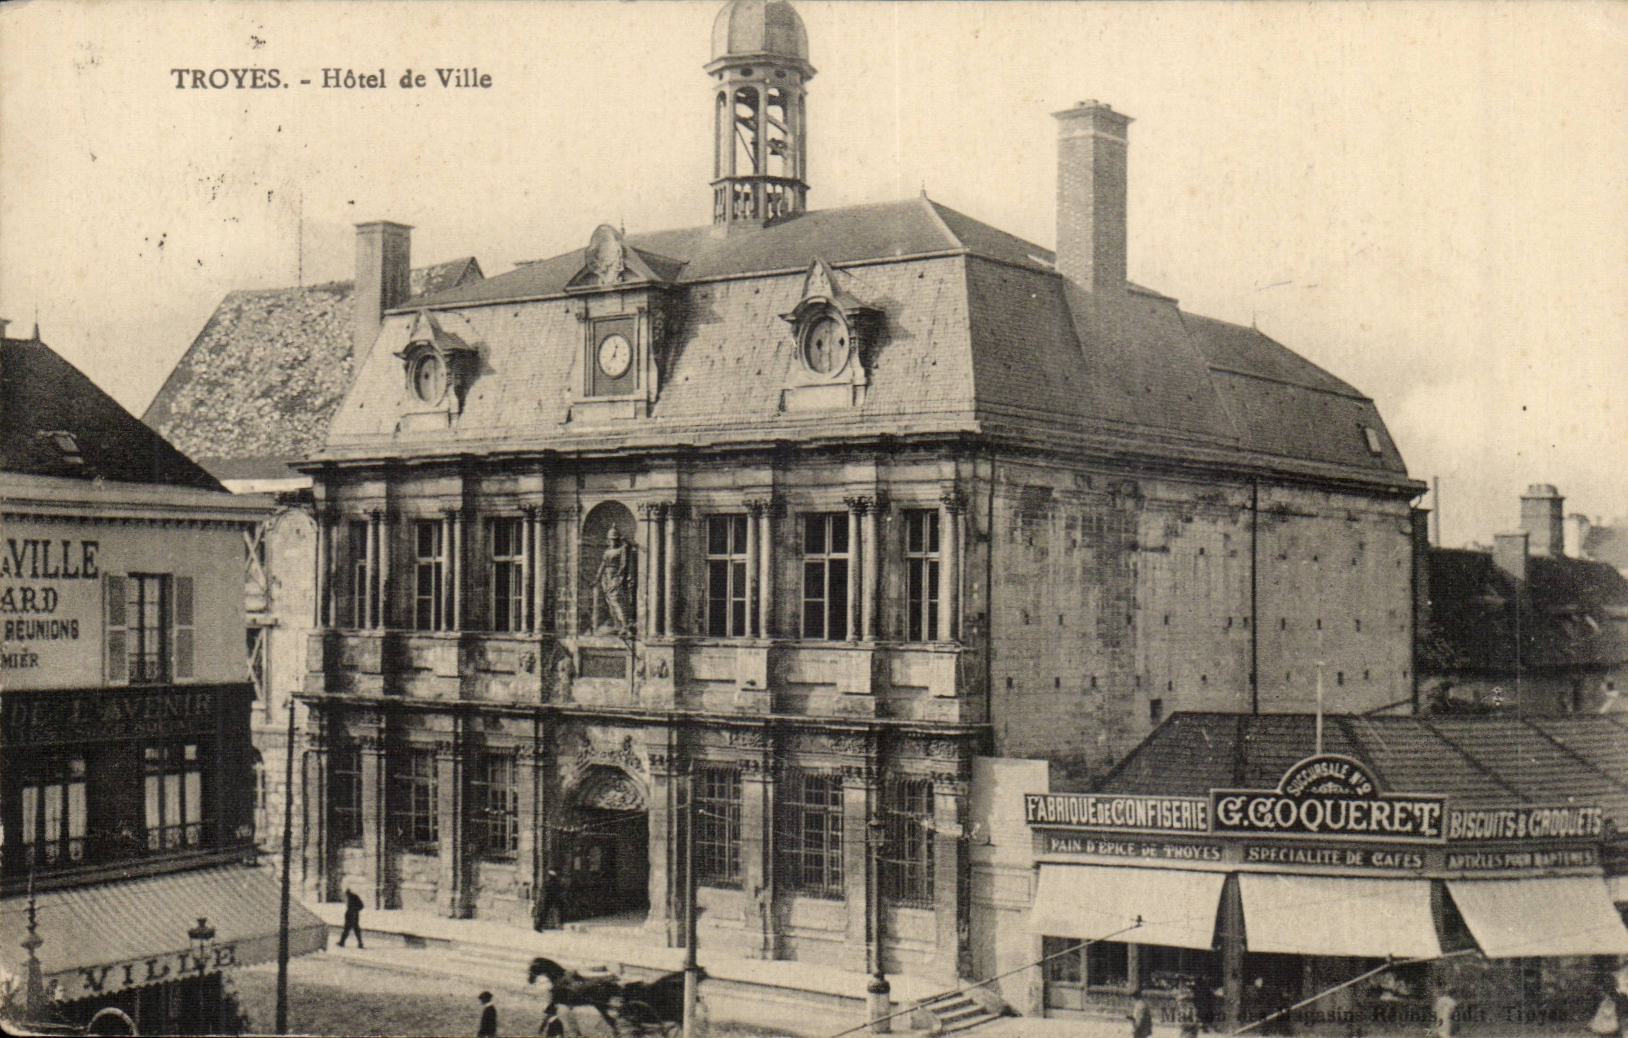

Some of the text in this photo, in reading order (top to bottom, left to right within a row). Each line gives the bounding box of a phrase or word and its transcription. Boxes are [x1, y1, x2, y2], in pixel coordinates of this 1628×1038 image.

[7, 538, 99, 579] VILLE
[1026, 795, 1208, 831] FABRIQUE DE CONFISERIE
[1450, 810, 1517, 839] BISCUITS
[1528, 807, 1602, 838] CROQUETS
[1051, 838, 1082, 853] PAIN
[1141, 843, 1158, 858] DE
[1165, 843, 1221, 862] TROYES
[1345, 851, 1364, 866] DE
